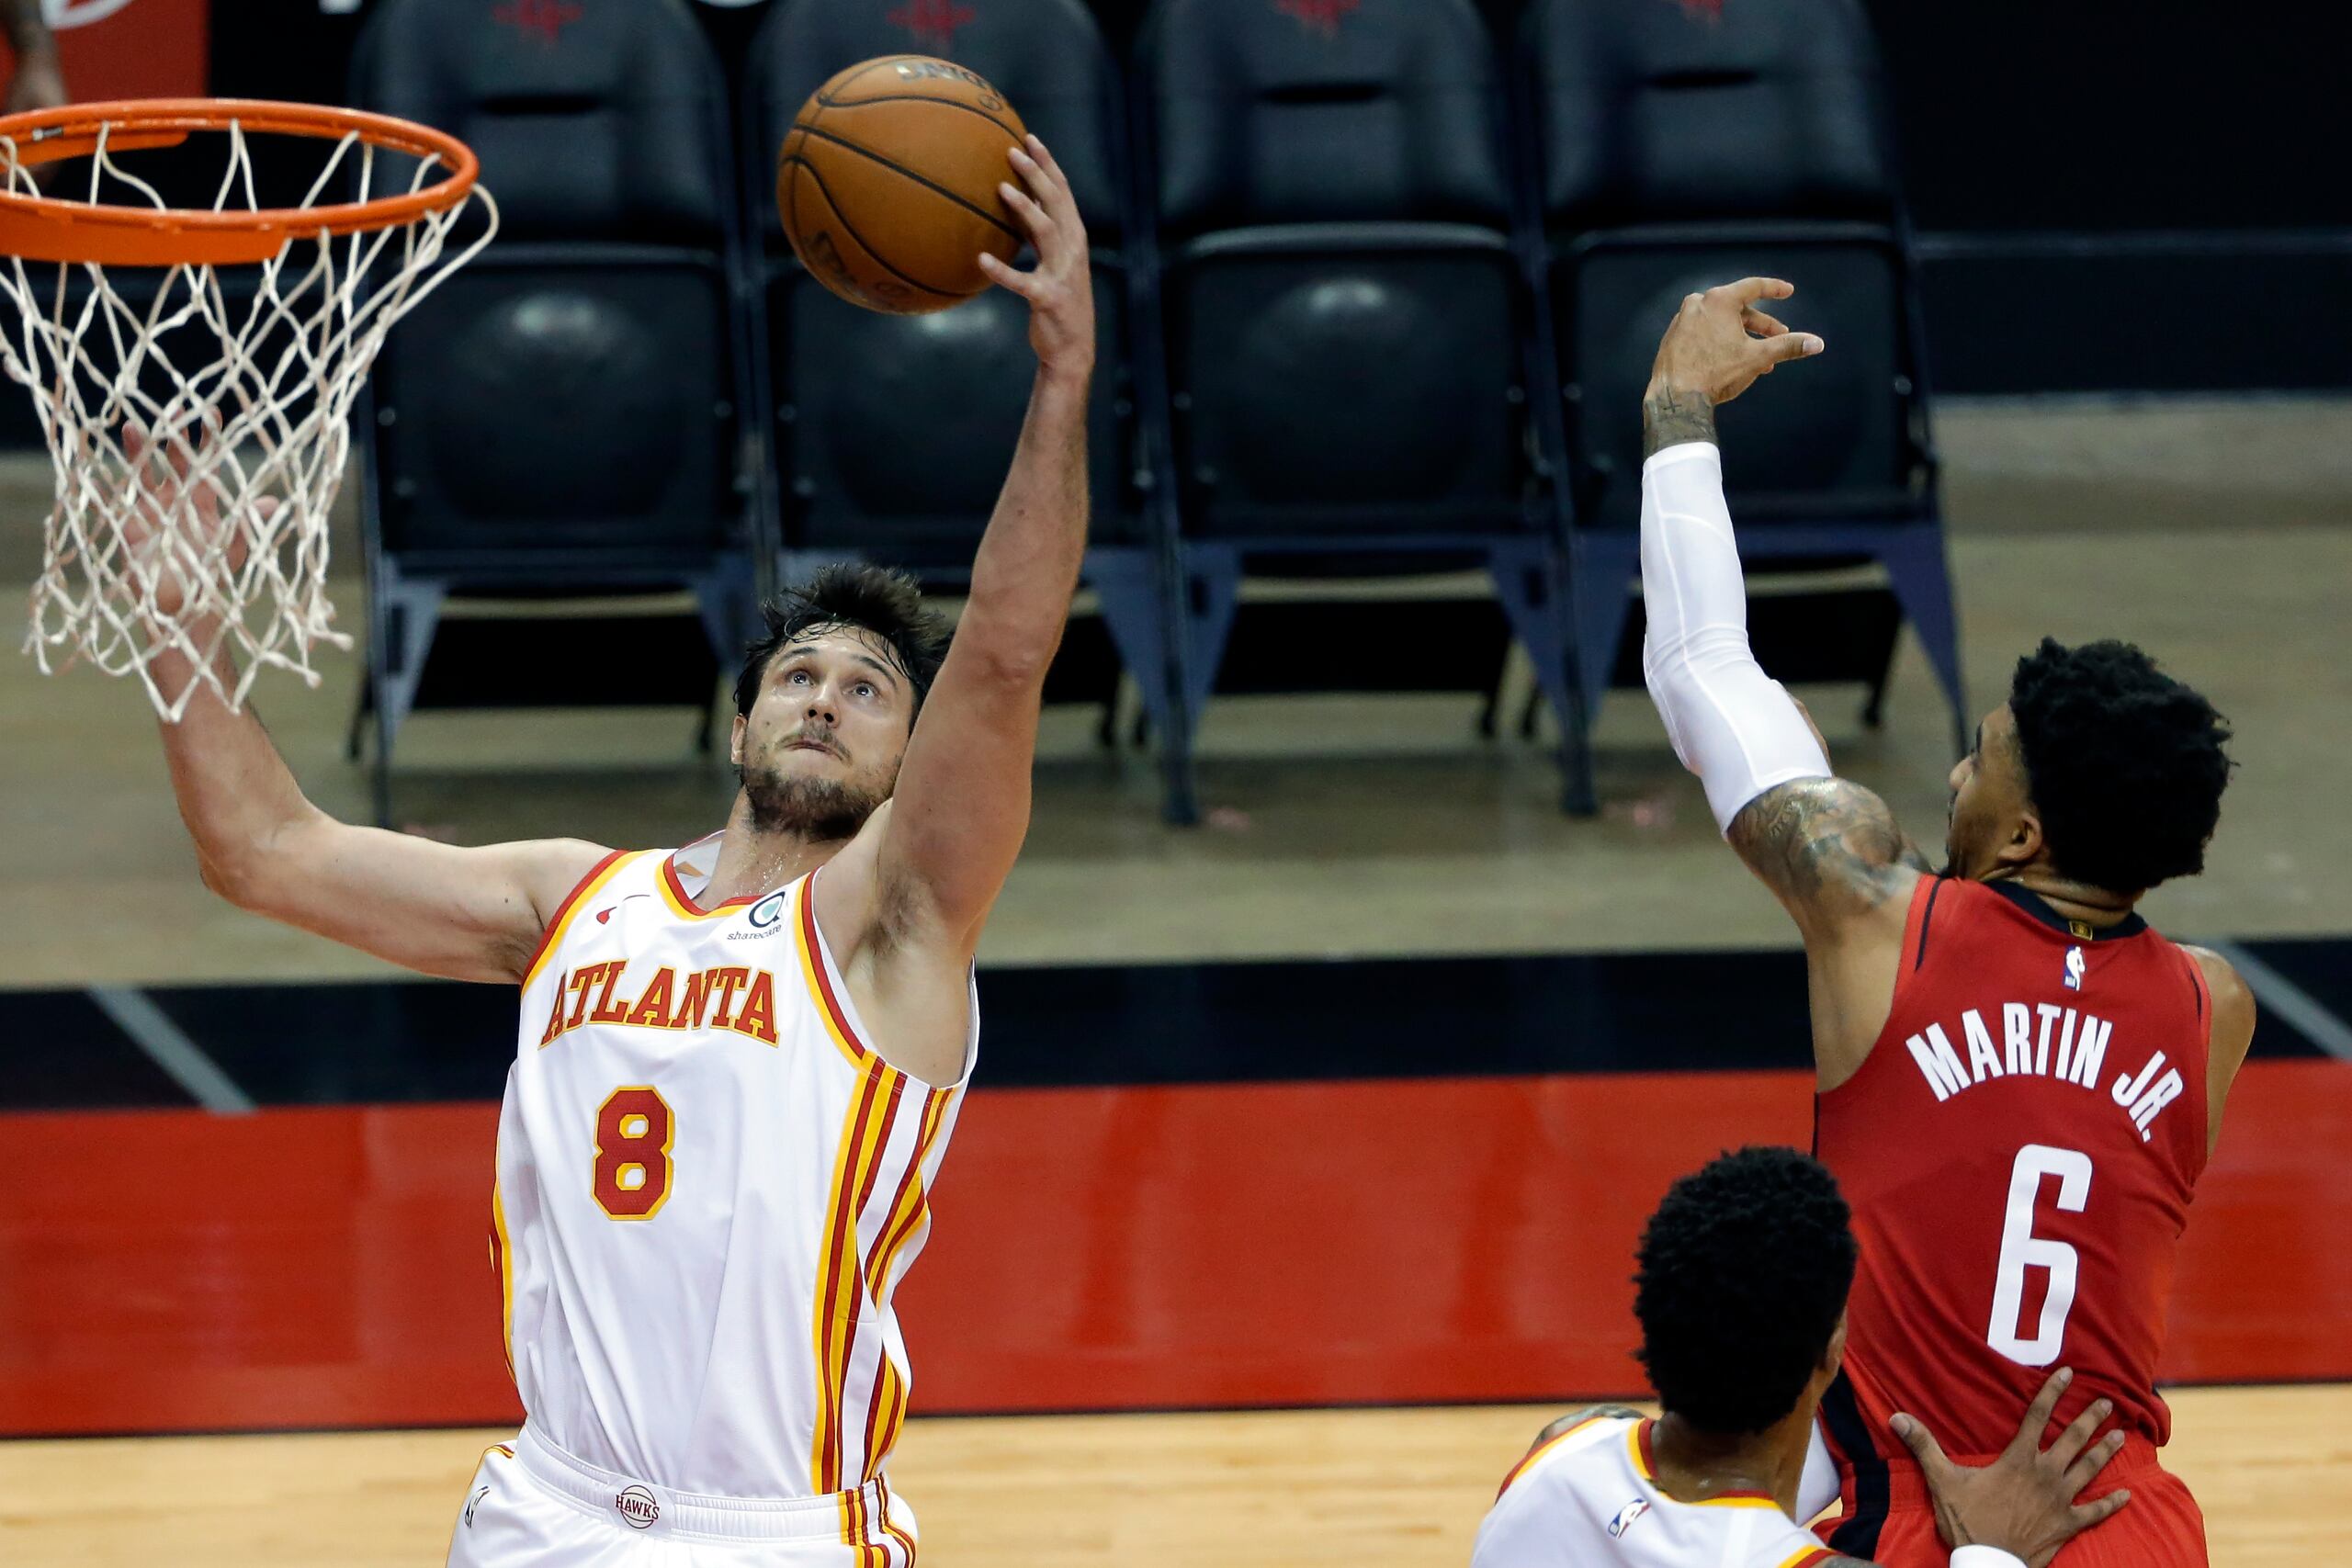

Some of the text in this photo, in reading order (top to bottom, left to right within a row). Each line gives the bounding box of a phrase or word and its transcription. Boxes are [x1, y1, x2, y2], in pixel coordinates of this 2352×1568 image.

[727, 924, 782, 940] sharecare
[537, 958, 780, 1048] ATLANTA
[1905, 1002, 2184, 1143] MARTIN JR.
[590, 1085, 676, 1222] 8
[1986, 1144, 2093, 1367] 6
[616, 1494, 661, 1520] HAWKS
